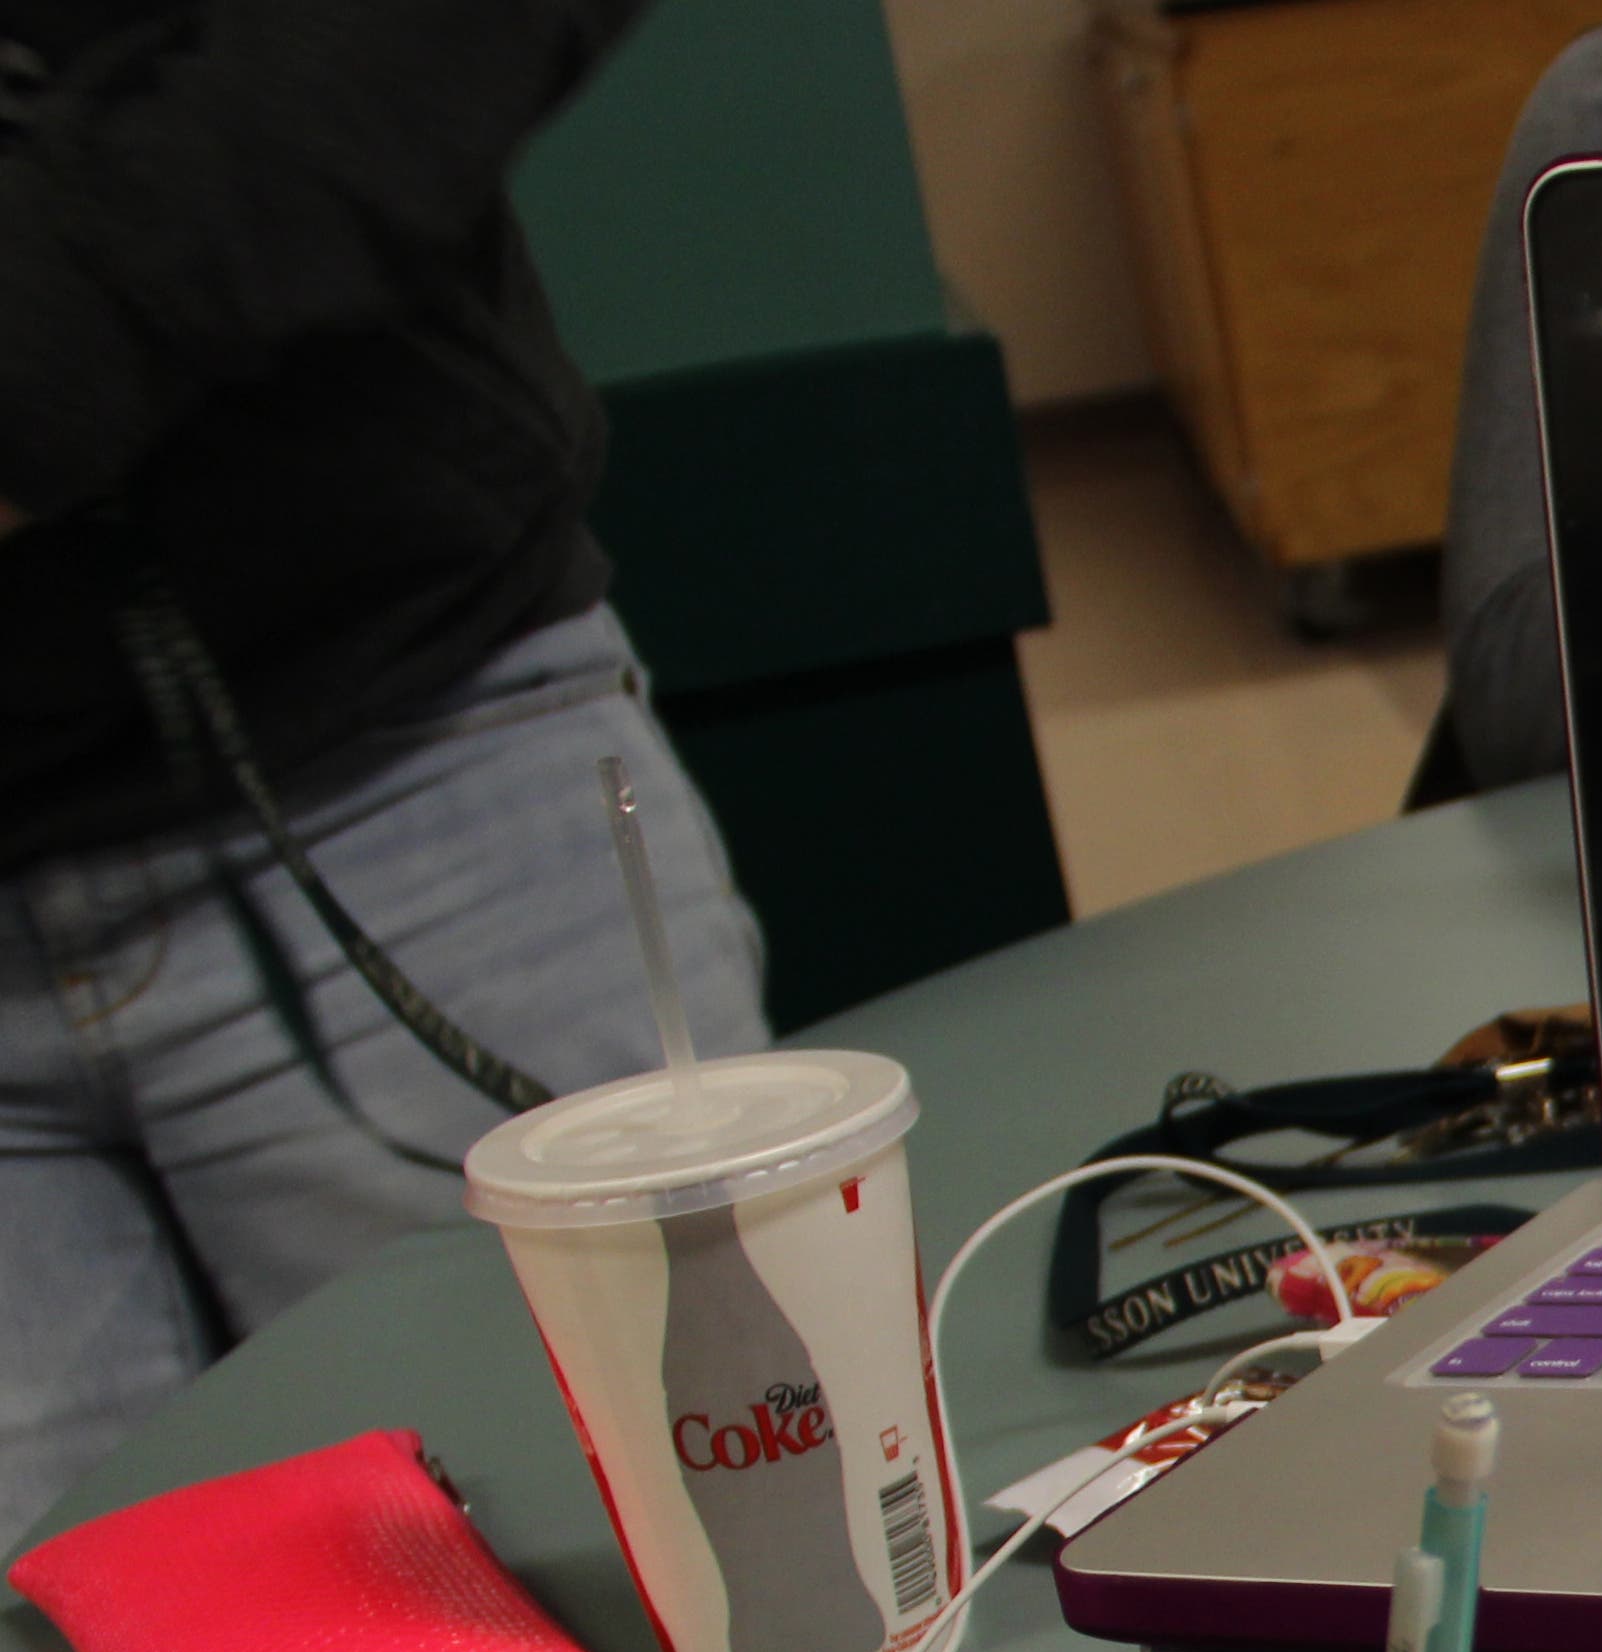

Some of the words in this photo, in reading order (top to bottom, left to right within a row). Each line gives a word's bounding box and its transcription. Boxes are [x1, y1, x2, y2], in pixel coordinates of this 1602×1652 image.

[1530, 1359, 1581, 1367] control
[766, 1383, 820, 1414] Diet
[673, 1403, 829, 1472] Coke
